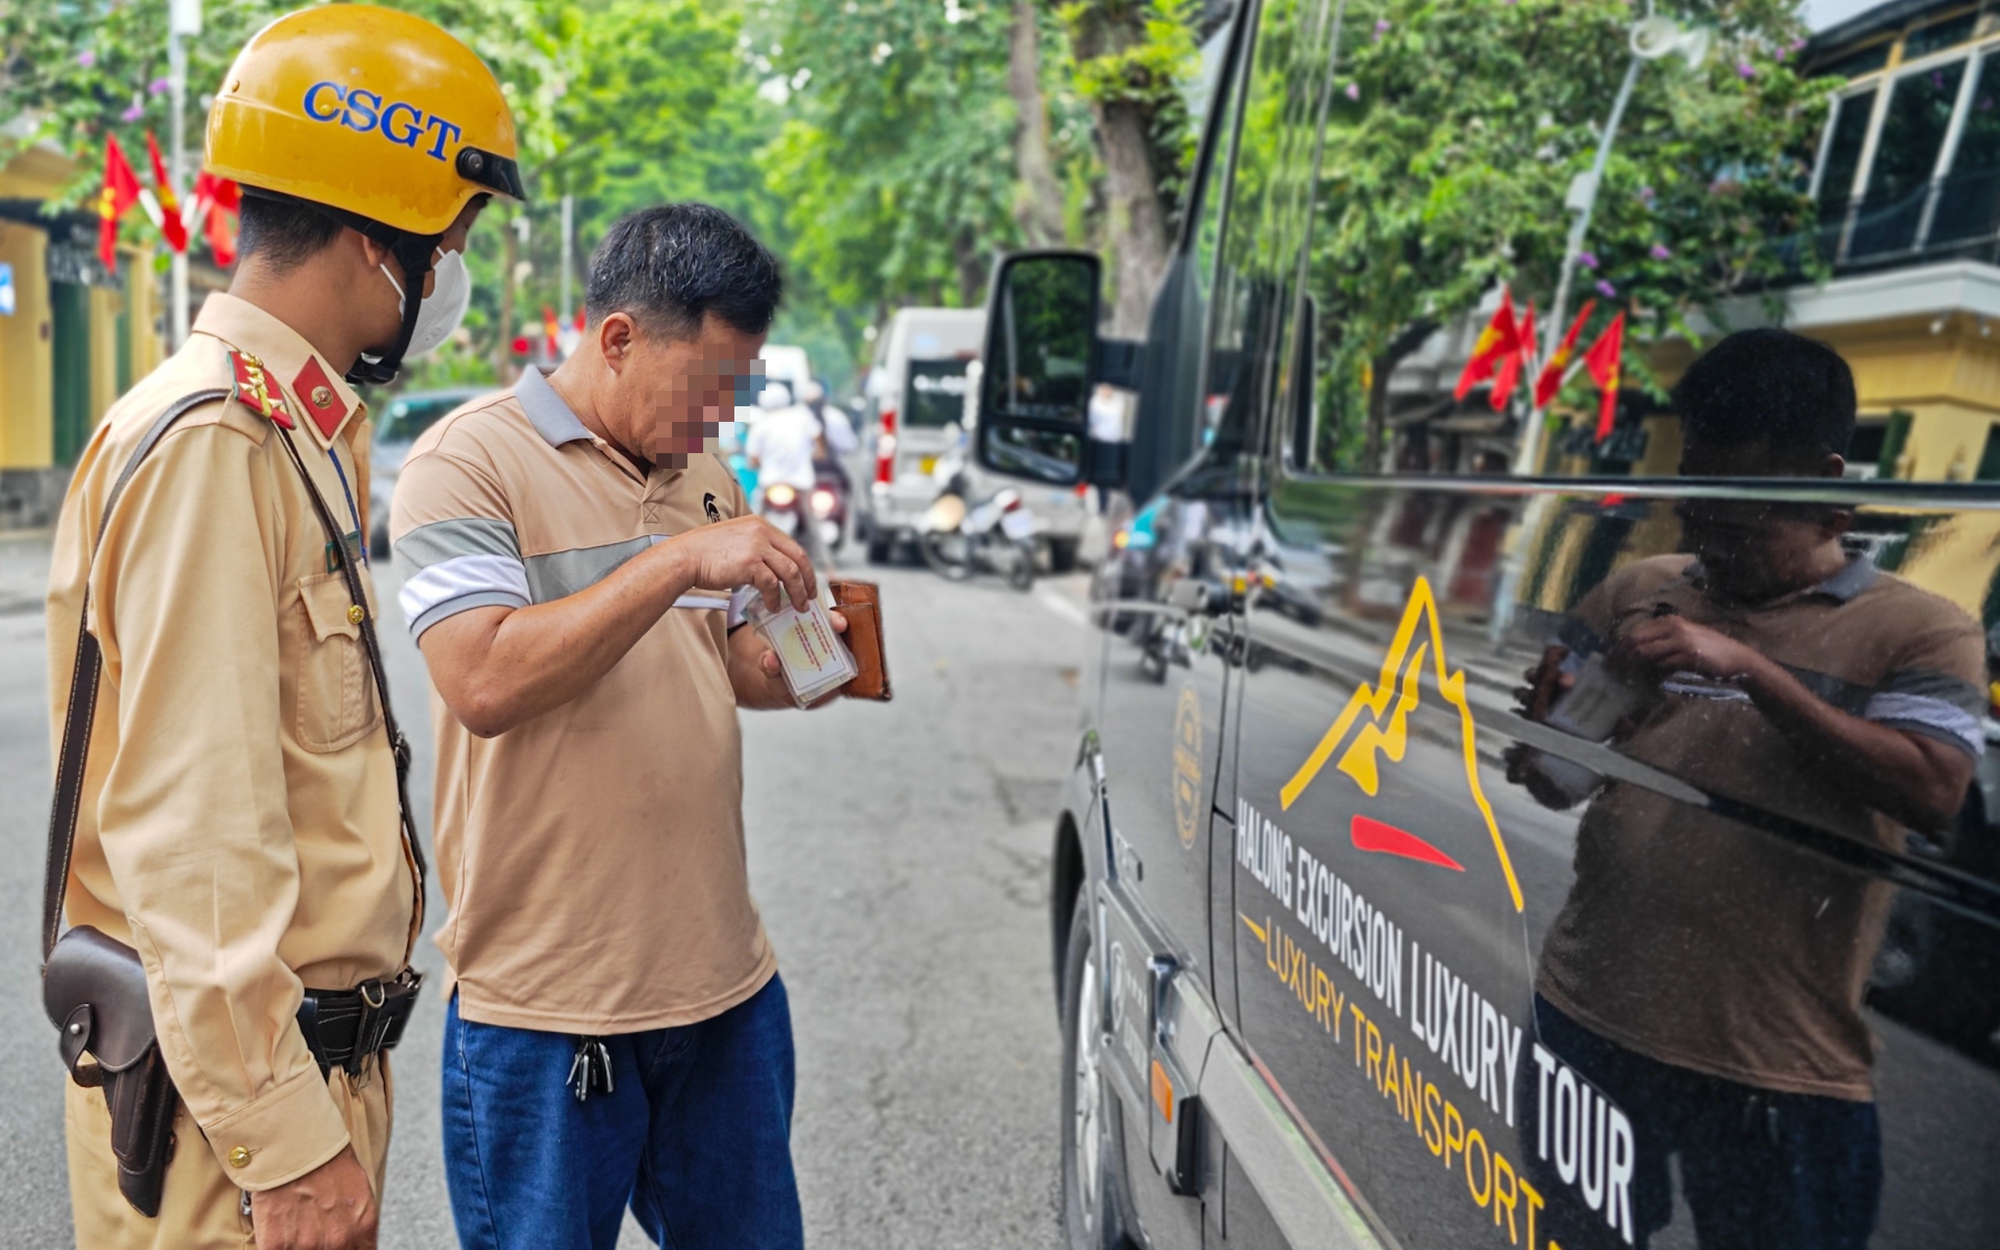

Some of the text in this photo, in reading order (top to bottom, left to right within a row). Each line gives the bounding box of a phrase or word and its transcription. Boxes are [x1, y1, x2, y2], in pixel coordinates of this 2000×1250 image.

[303, 81, 461, 162] CSGT
[1237, 798, 1634, 1245] HALONG EXCURSION LUXURY TOUR
[1266, 916, 1545, 1250] LUXURY TRANSPORT
